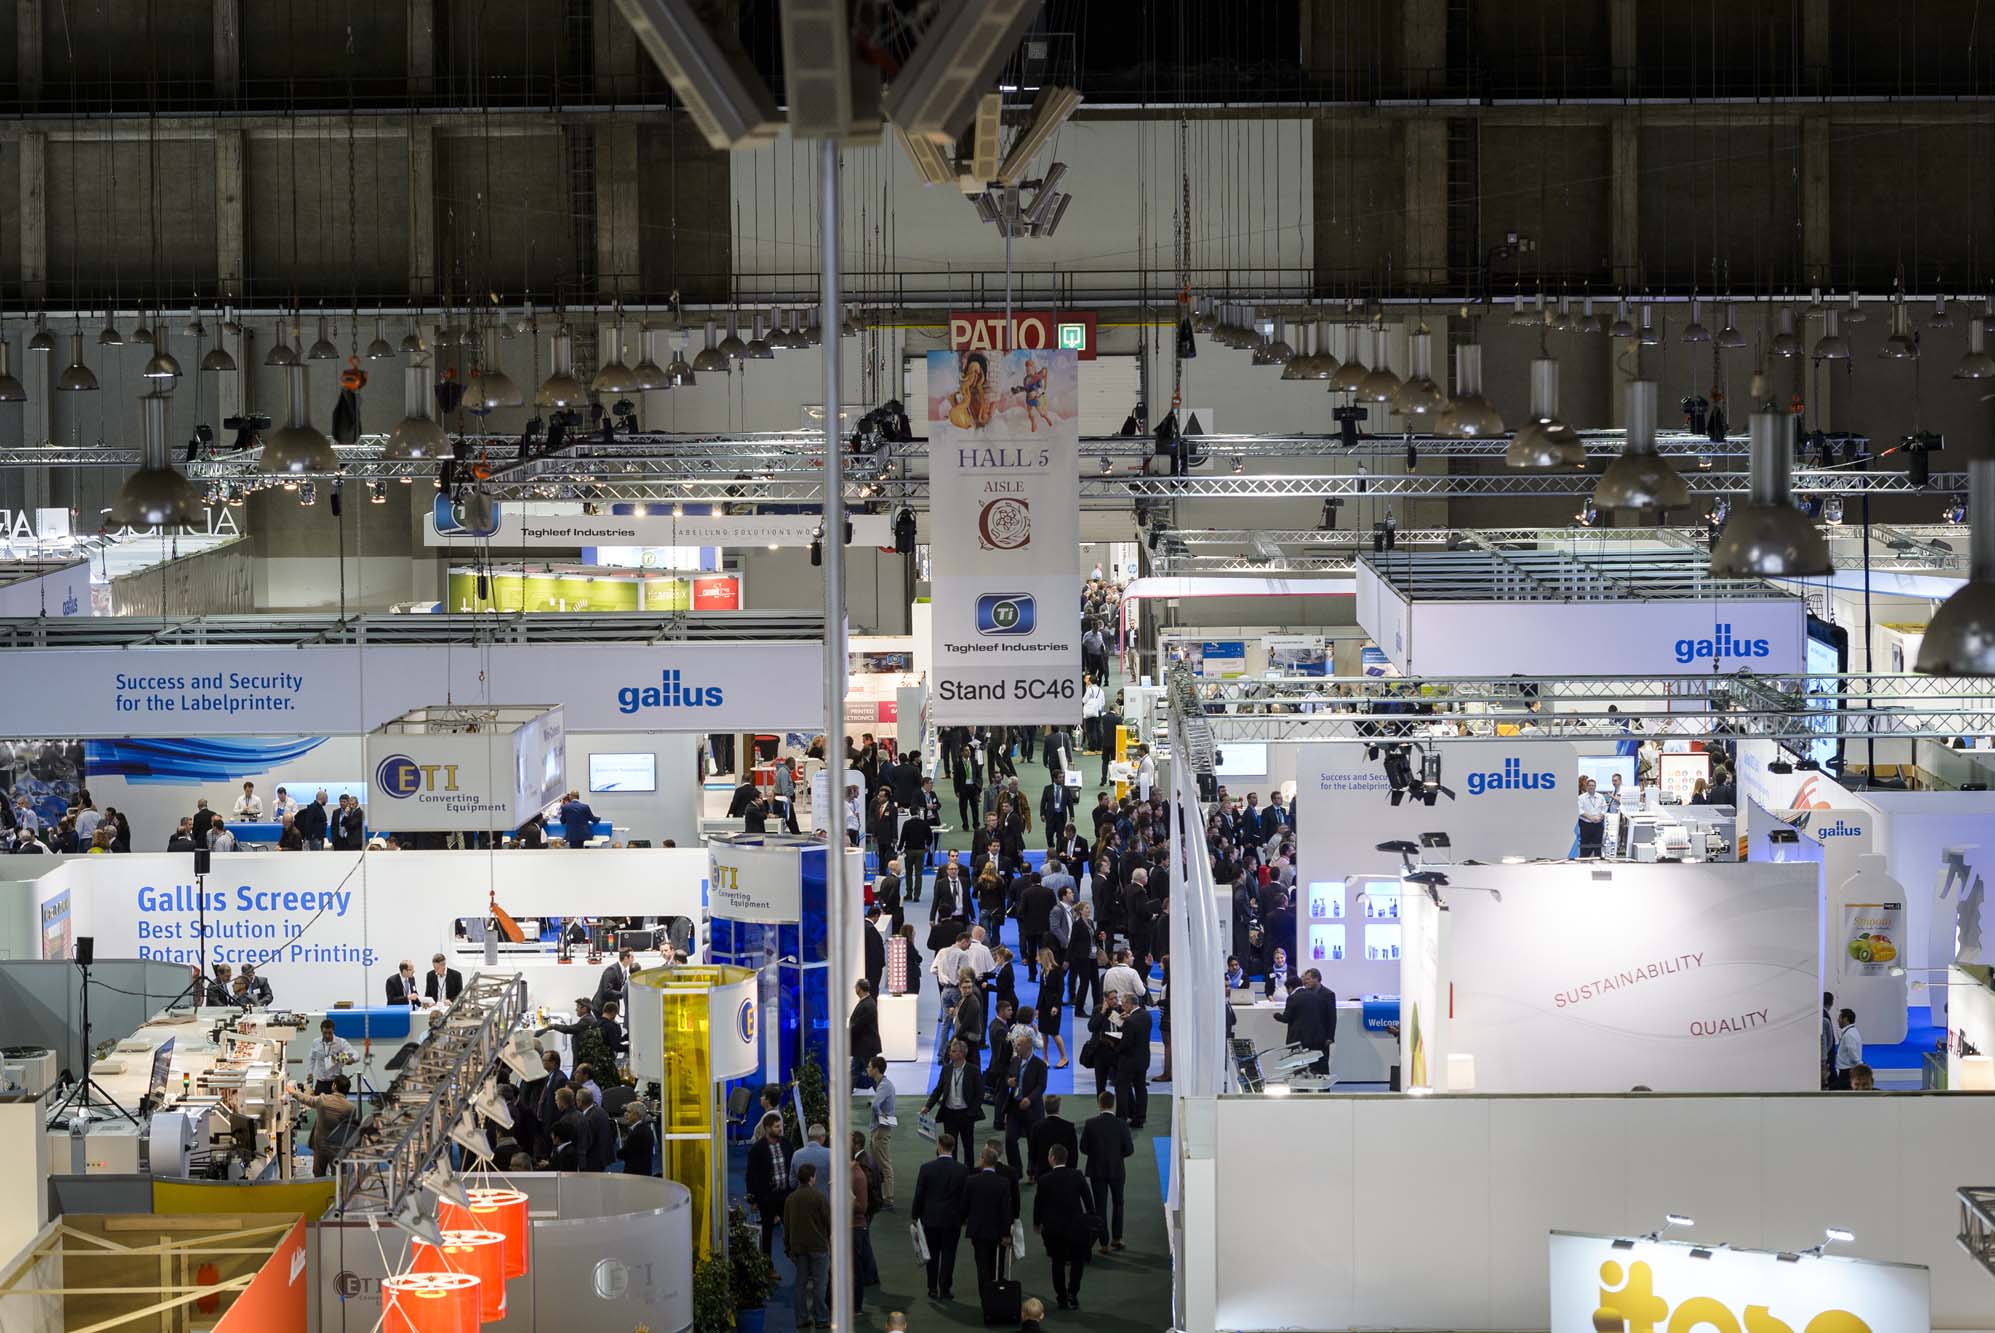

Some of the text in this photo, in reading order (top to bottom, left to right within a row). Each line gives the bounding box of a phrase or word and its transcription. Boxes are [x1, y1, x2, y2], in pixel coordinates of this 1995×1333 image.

[951, 318, 1045, 350] PATIO
[959, 449, 1049, 468] HALL 5
[984, 481, 1025, 492] AISLE
[521, 527, 636, 539] Taghleef Industries
[997, 606, 1015, 621] Ti
[944, 643, 1069, 654] Taghleef Industries
[1675, 623, 1770, 663] gallus
[116, 672, 303, 695] Success and Security
[618, 670, 723, 714] gallus
[939, 679, 1075, 700] Stand 5C46
[116, 693, 295, 714] for the Labelprinter.
[399, 765, 459, 792] ETI
[1321, 773, 1389, 781] Success and Secu
[1467, 758, 1555, 795] gallus
[1320, 782, 1392, 792] for the Labelprinte
[418, 794, 479, 805] Converting
[446, 803, 507, 813] Equipment
[1818, 820, 1862, 840] gallus
[138, 885, 352, 917] Gallus Screeny
[730, 899, 771, 909] Equipment
[138, 919, 303, 939] Best Solution in
[213, 944, 283, 963] Screen
[291, 944, 380, 966] Printing.
[1554, 952, 1705, 1009] SUSTAINABILITY
[1690, 1008, 1769, 1037] QUALITY
